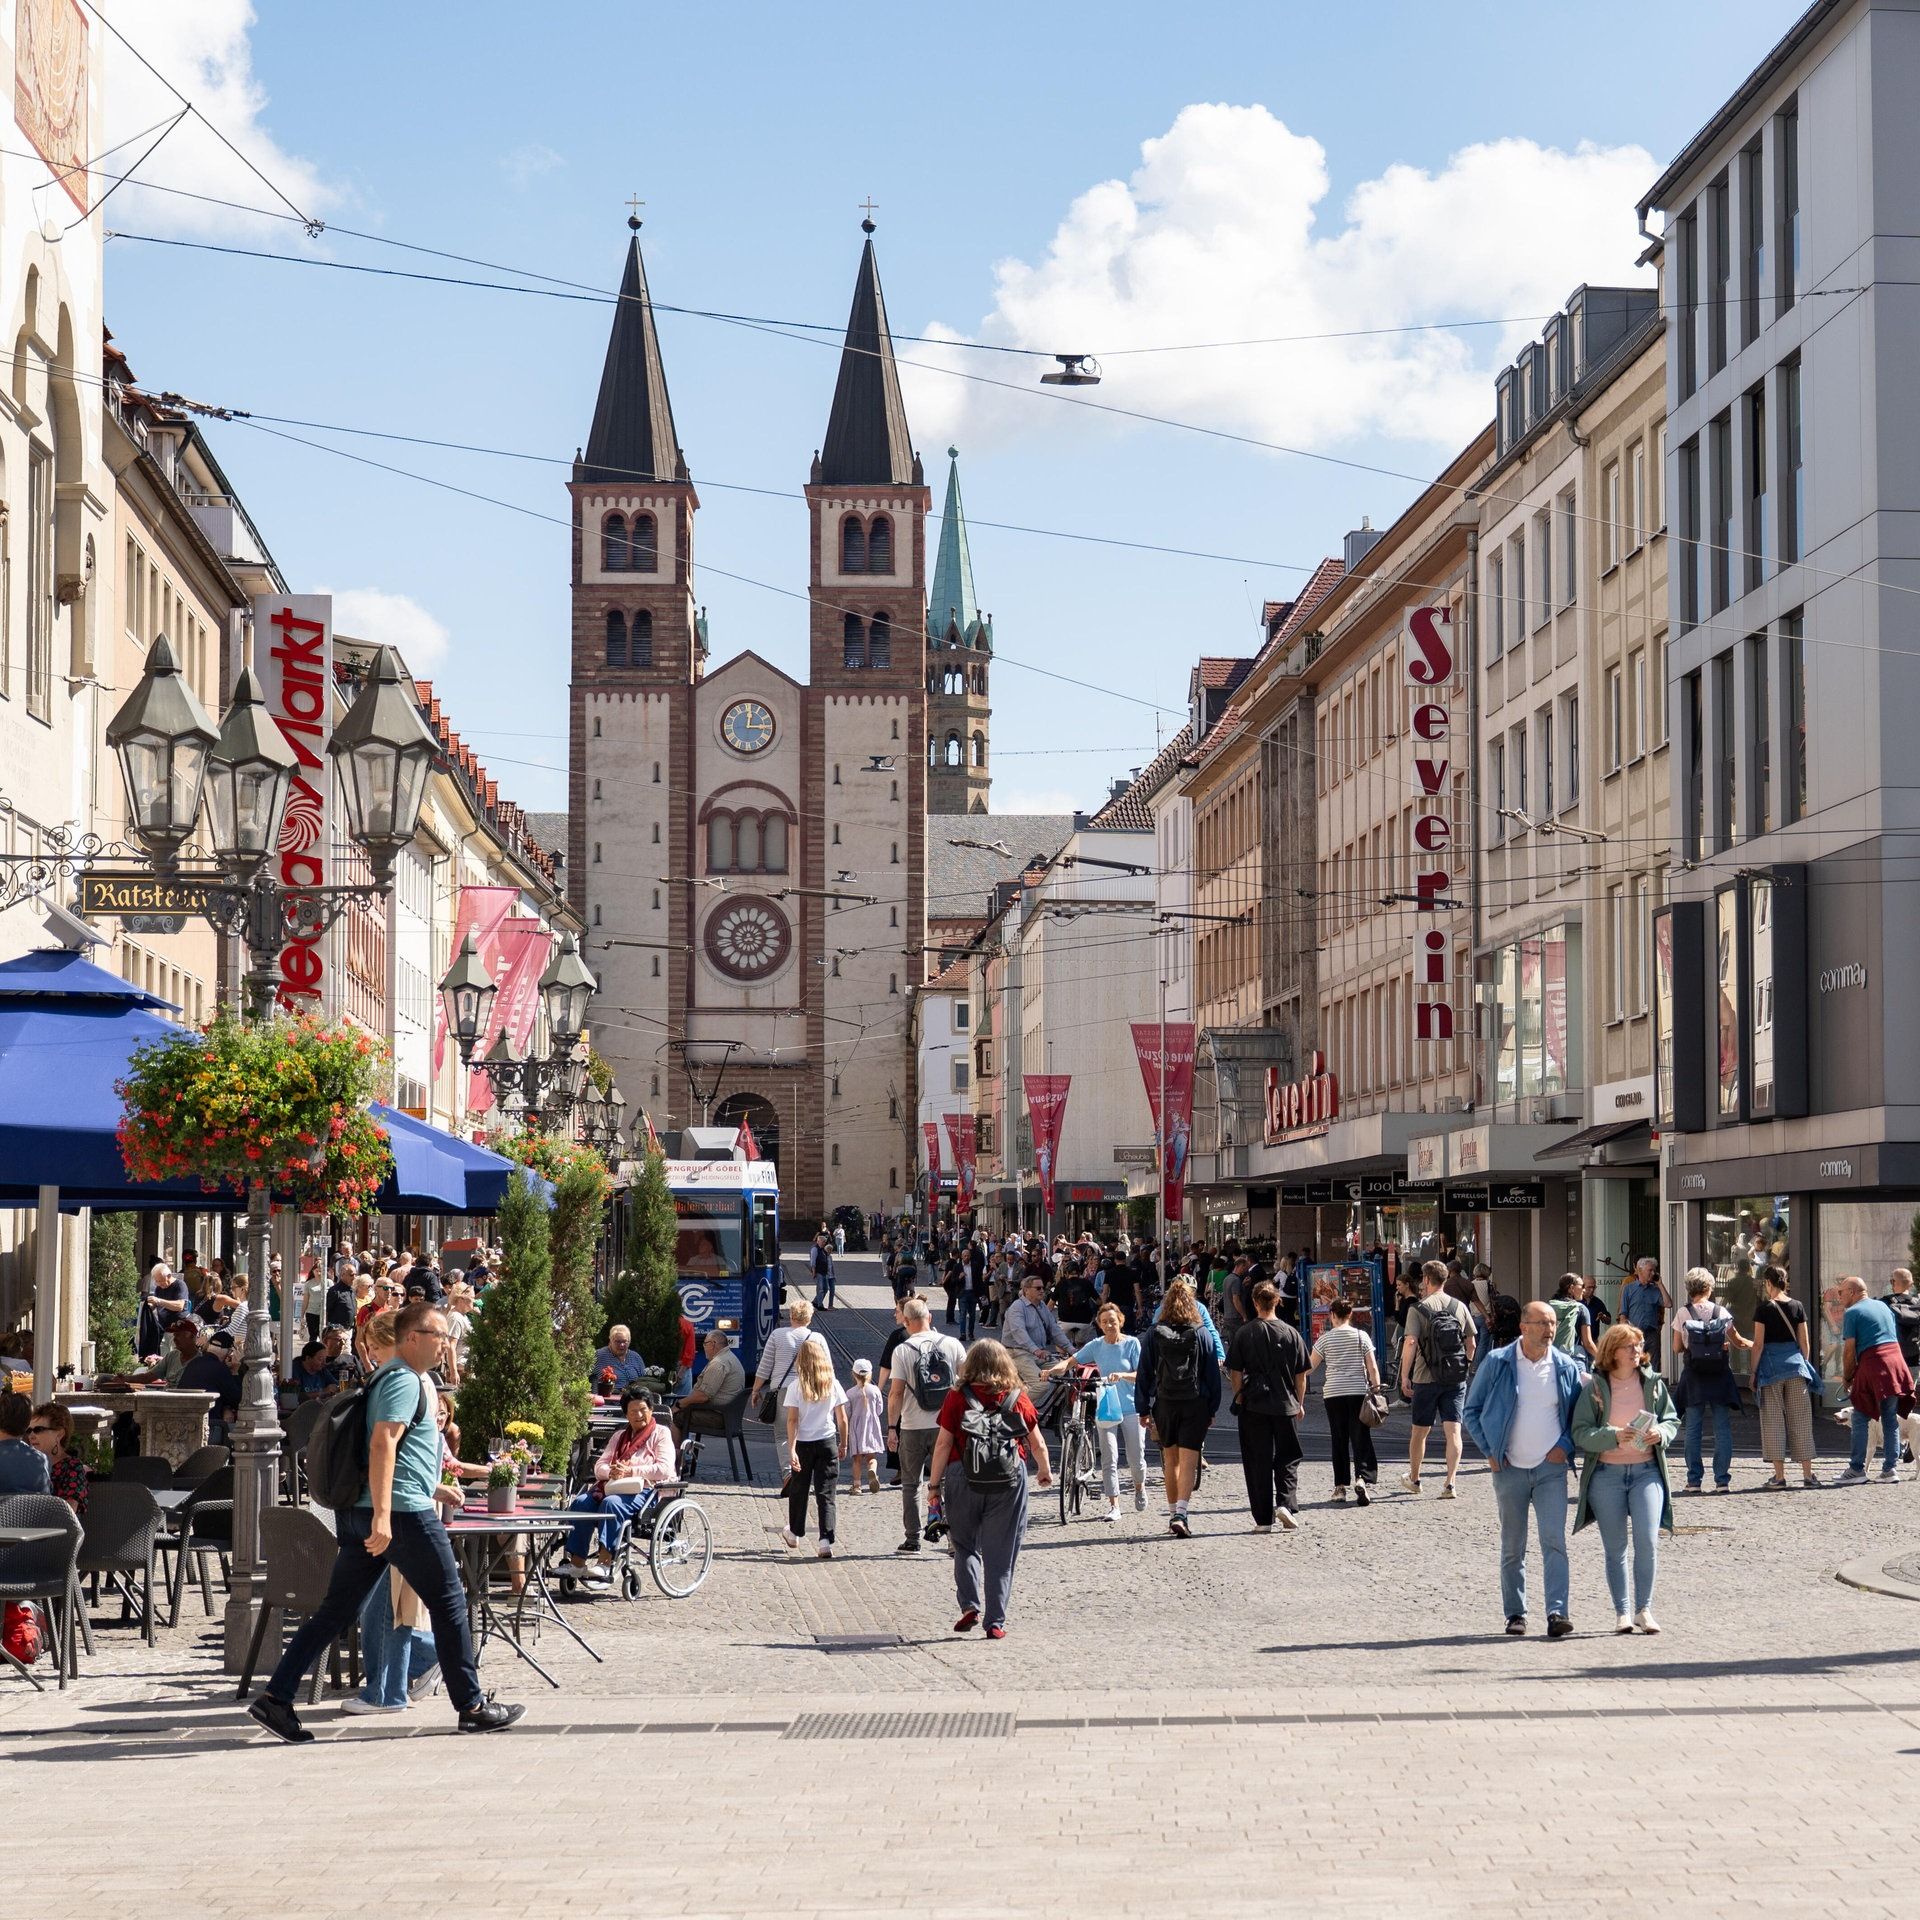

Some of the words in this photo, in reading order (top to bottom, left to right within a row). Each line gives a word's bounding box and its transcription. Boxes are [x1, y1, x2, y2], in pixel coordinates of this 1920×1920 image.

[1408, 605, 1454, 1040] Severin
[93, 882, 209, 908] Ratske
[1263, 1050, 1338, 1146] Severin
[1397, 1179, 1436, 1187] Barbour
[1497, 1196, 1538, 1204] LACOSTE
